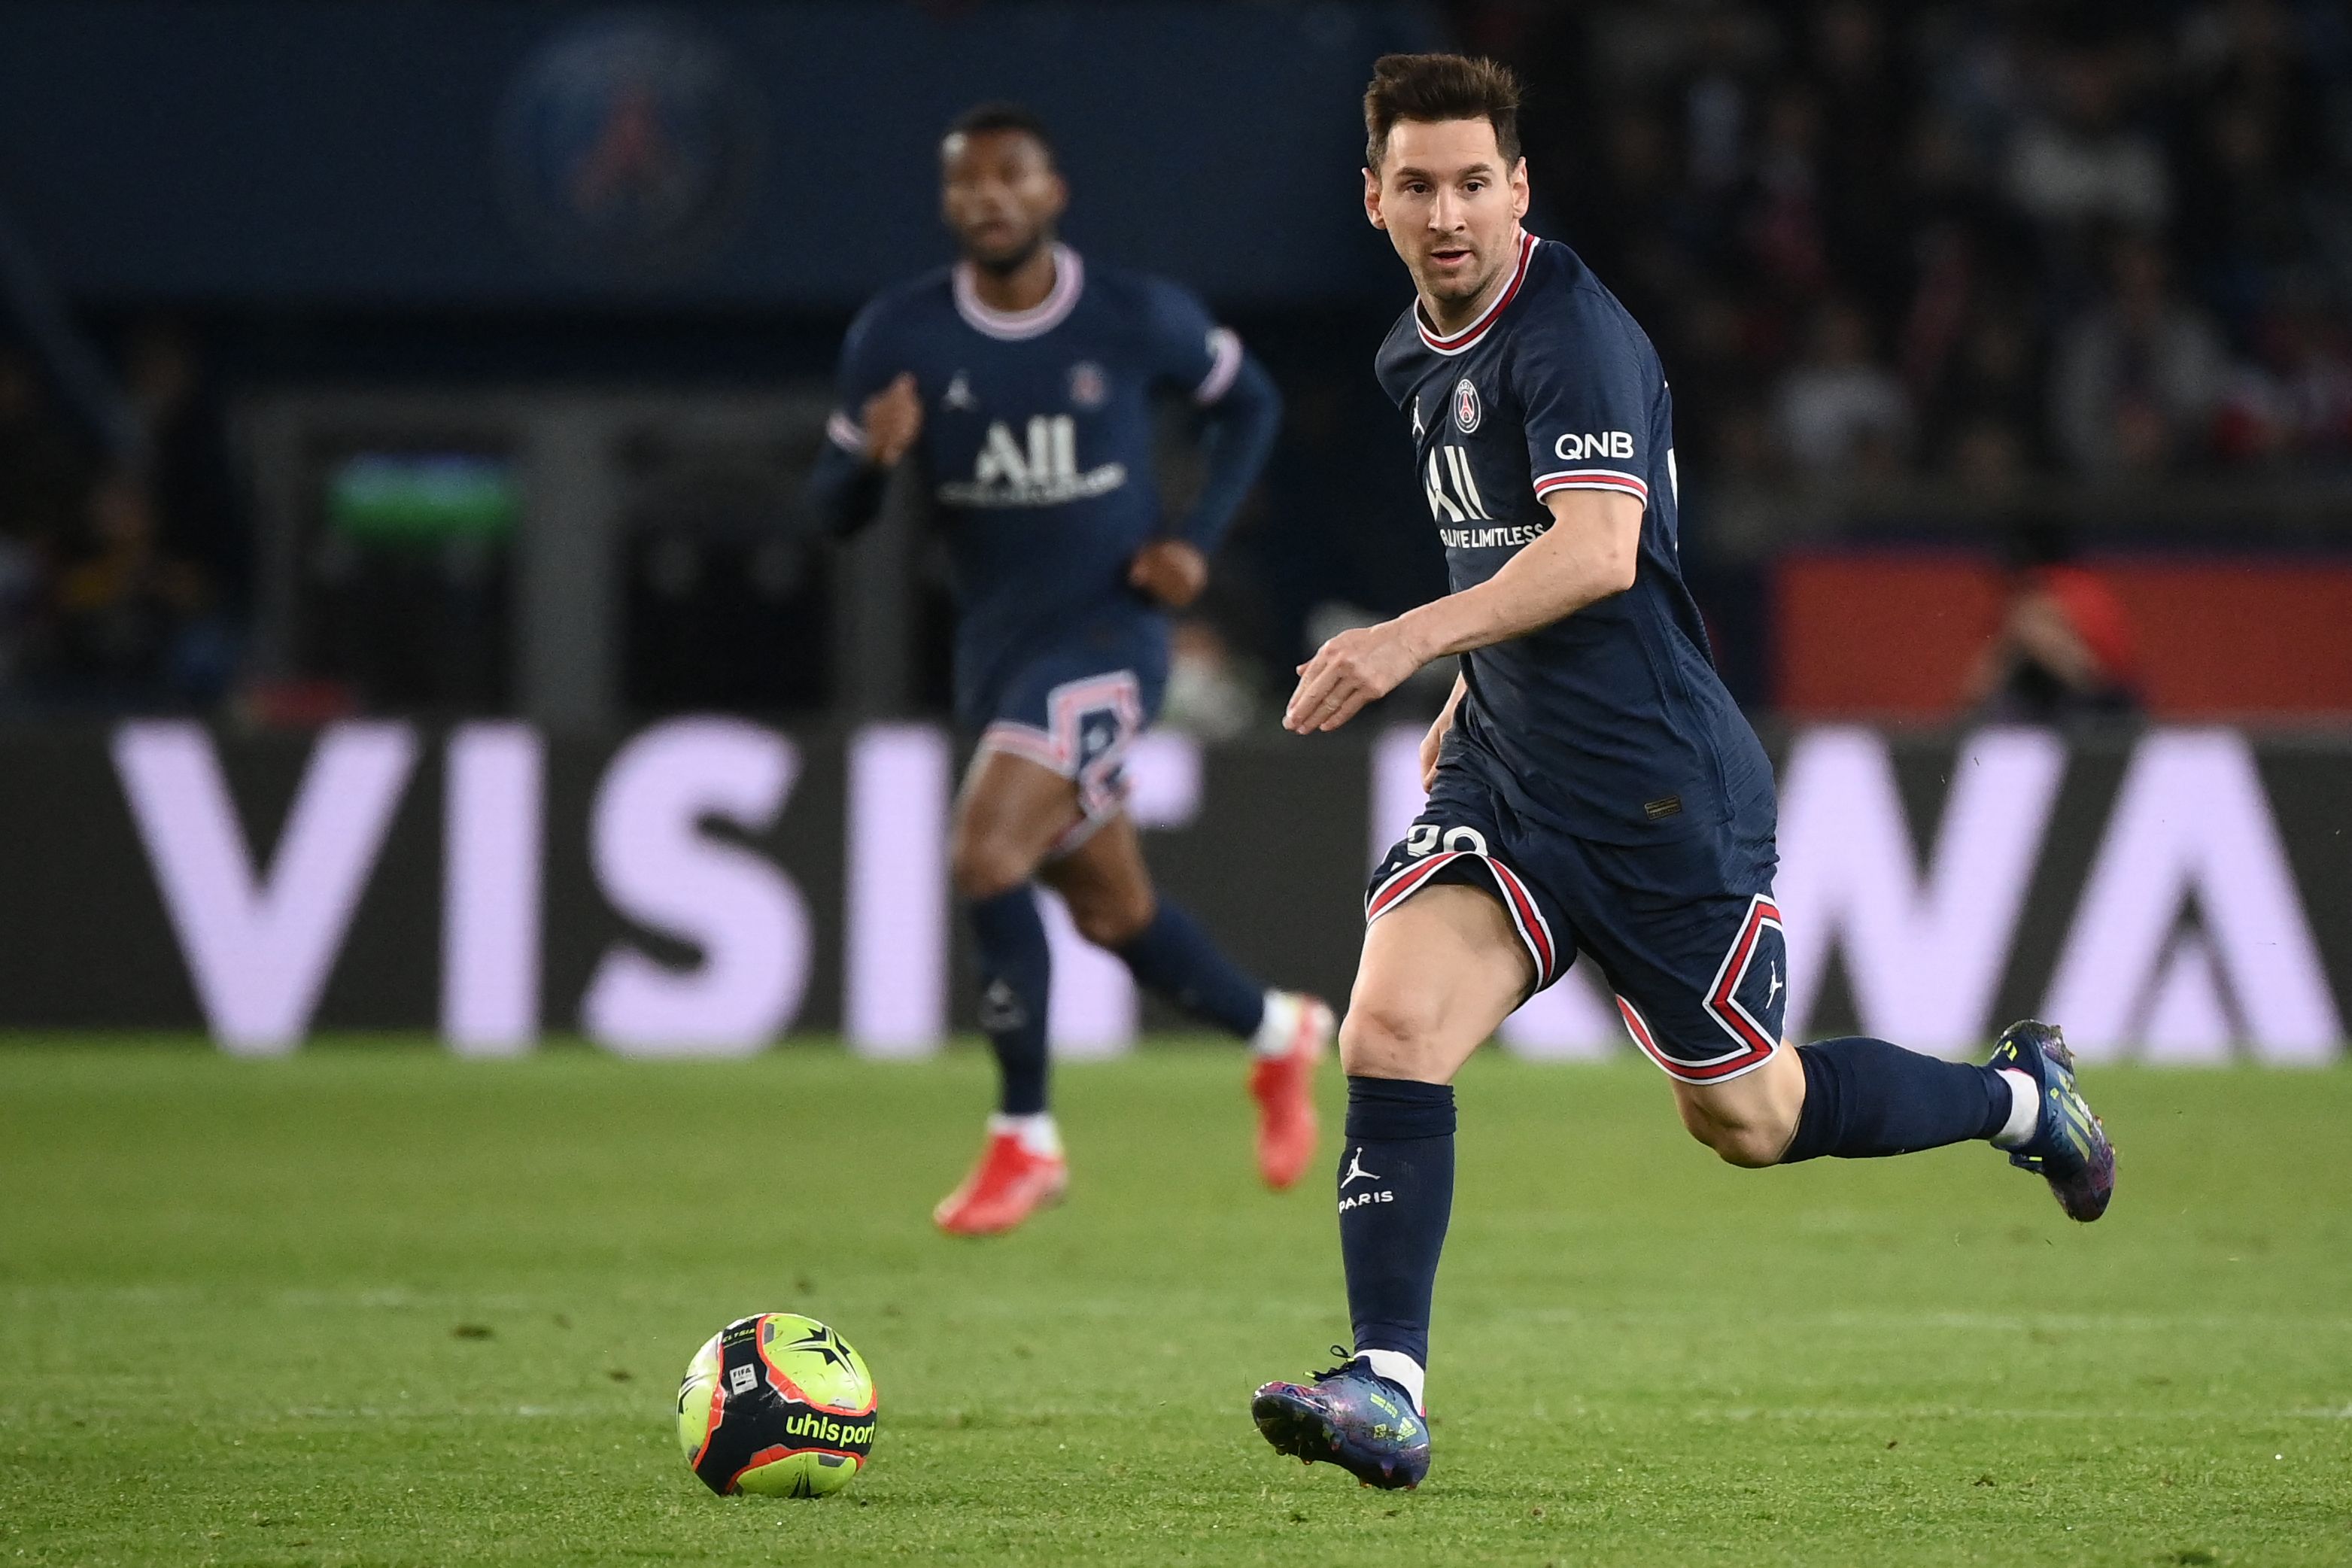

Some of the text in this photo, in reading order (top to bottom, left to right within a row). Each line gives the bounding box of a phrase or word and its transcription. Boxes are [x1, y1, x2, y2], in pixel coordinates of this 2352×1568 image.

[1554, 430, 1634, 460] QNB
[1339, 1190, 1394, 1214] PARIS
[733, 1367, 752, 1378] FIFA
[786, 1413, 875, 1448] uhlsport
